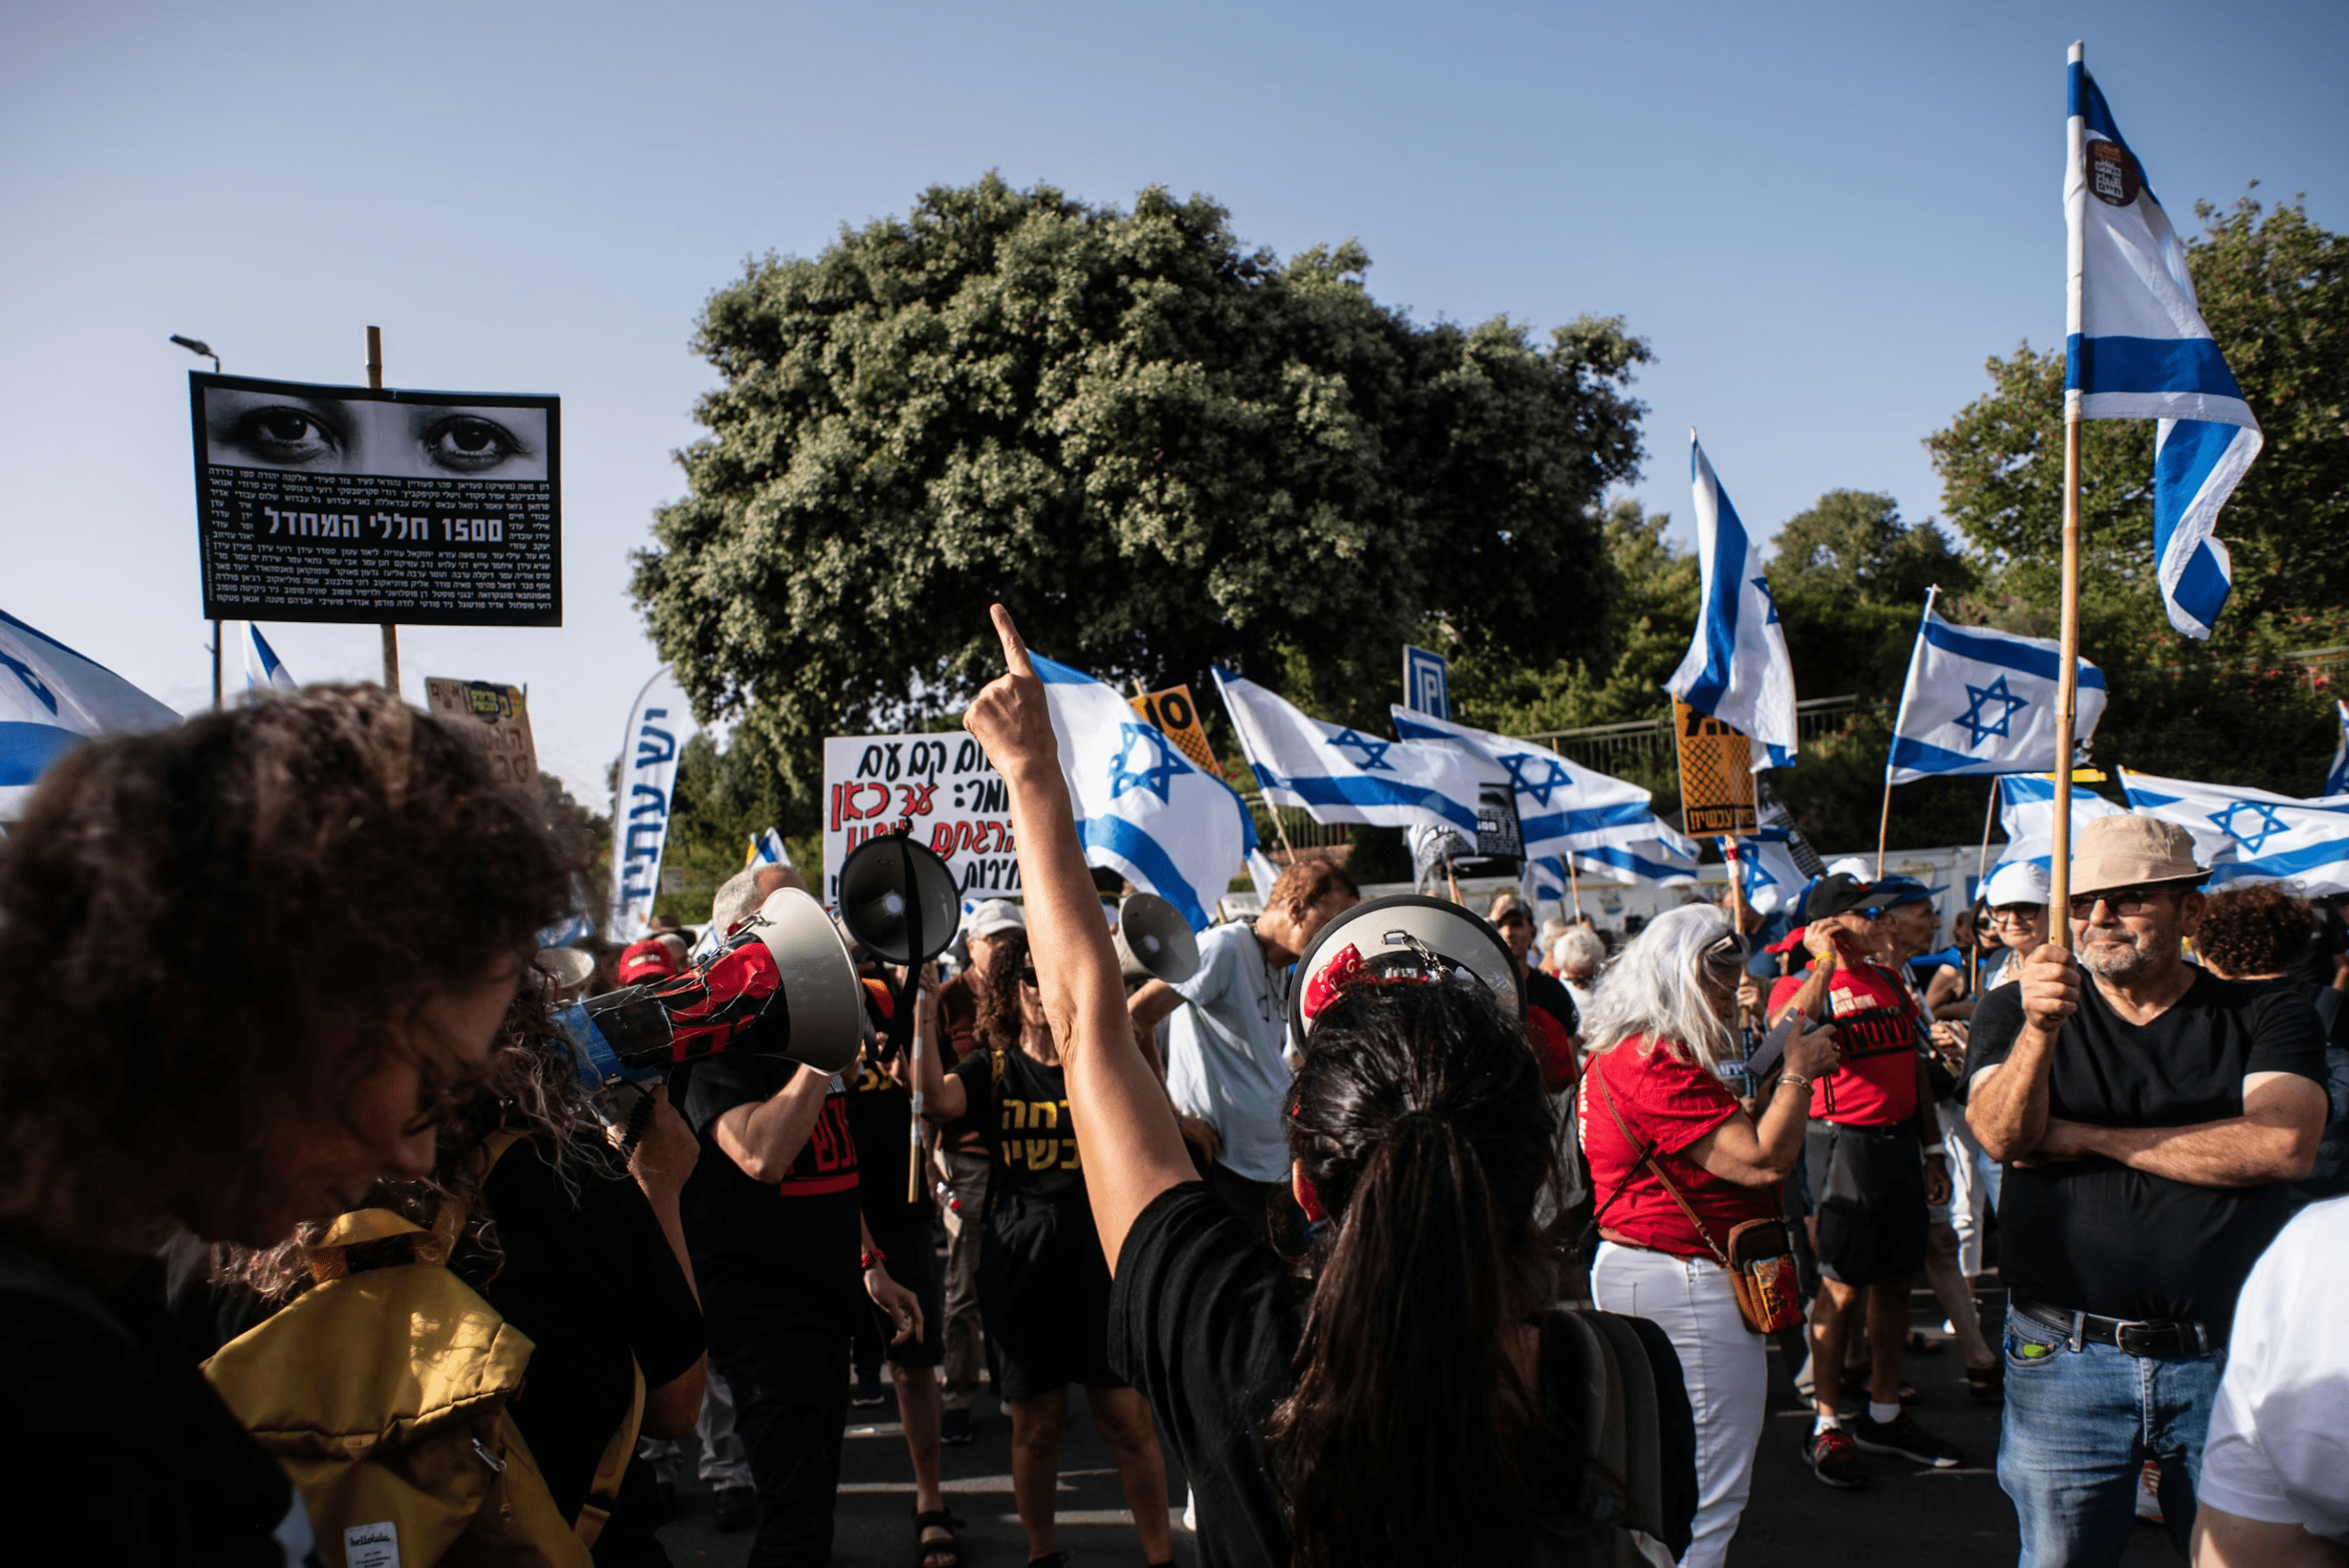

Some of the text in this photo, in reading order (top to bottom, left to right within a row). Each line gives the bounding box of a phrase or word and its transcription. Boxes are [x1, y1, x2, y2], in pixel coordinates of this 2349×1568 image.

[263, 506, 503, 542] 1500 חללי המחדל
[1145, 693, 1192, 732] 10
[635, 708, 675, 769] יש
[857, 743, 903, 782] עם
[907, 740, 947, 784] קם
[831, 782, 890, 831] כאן
[896, 783, 939, 817] עד
[621, 784, 667, 902] עתיד
